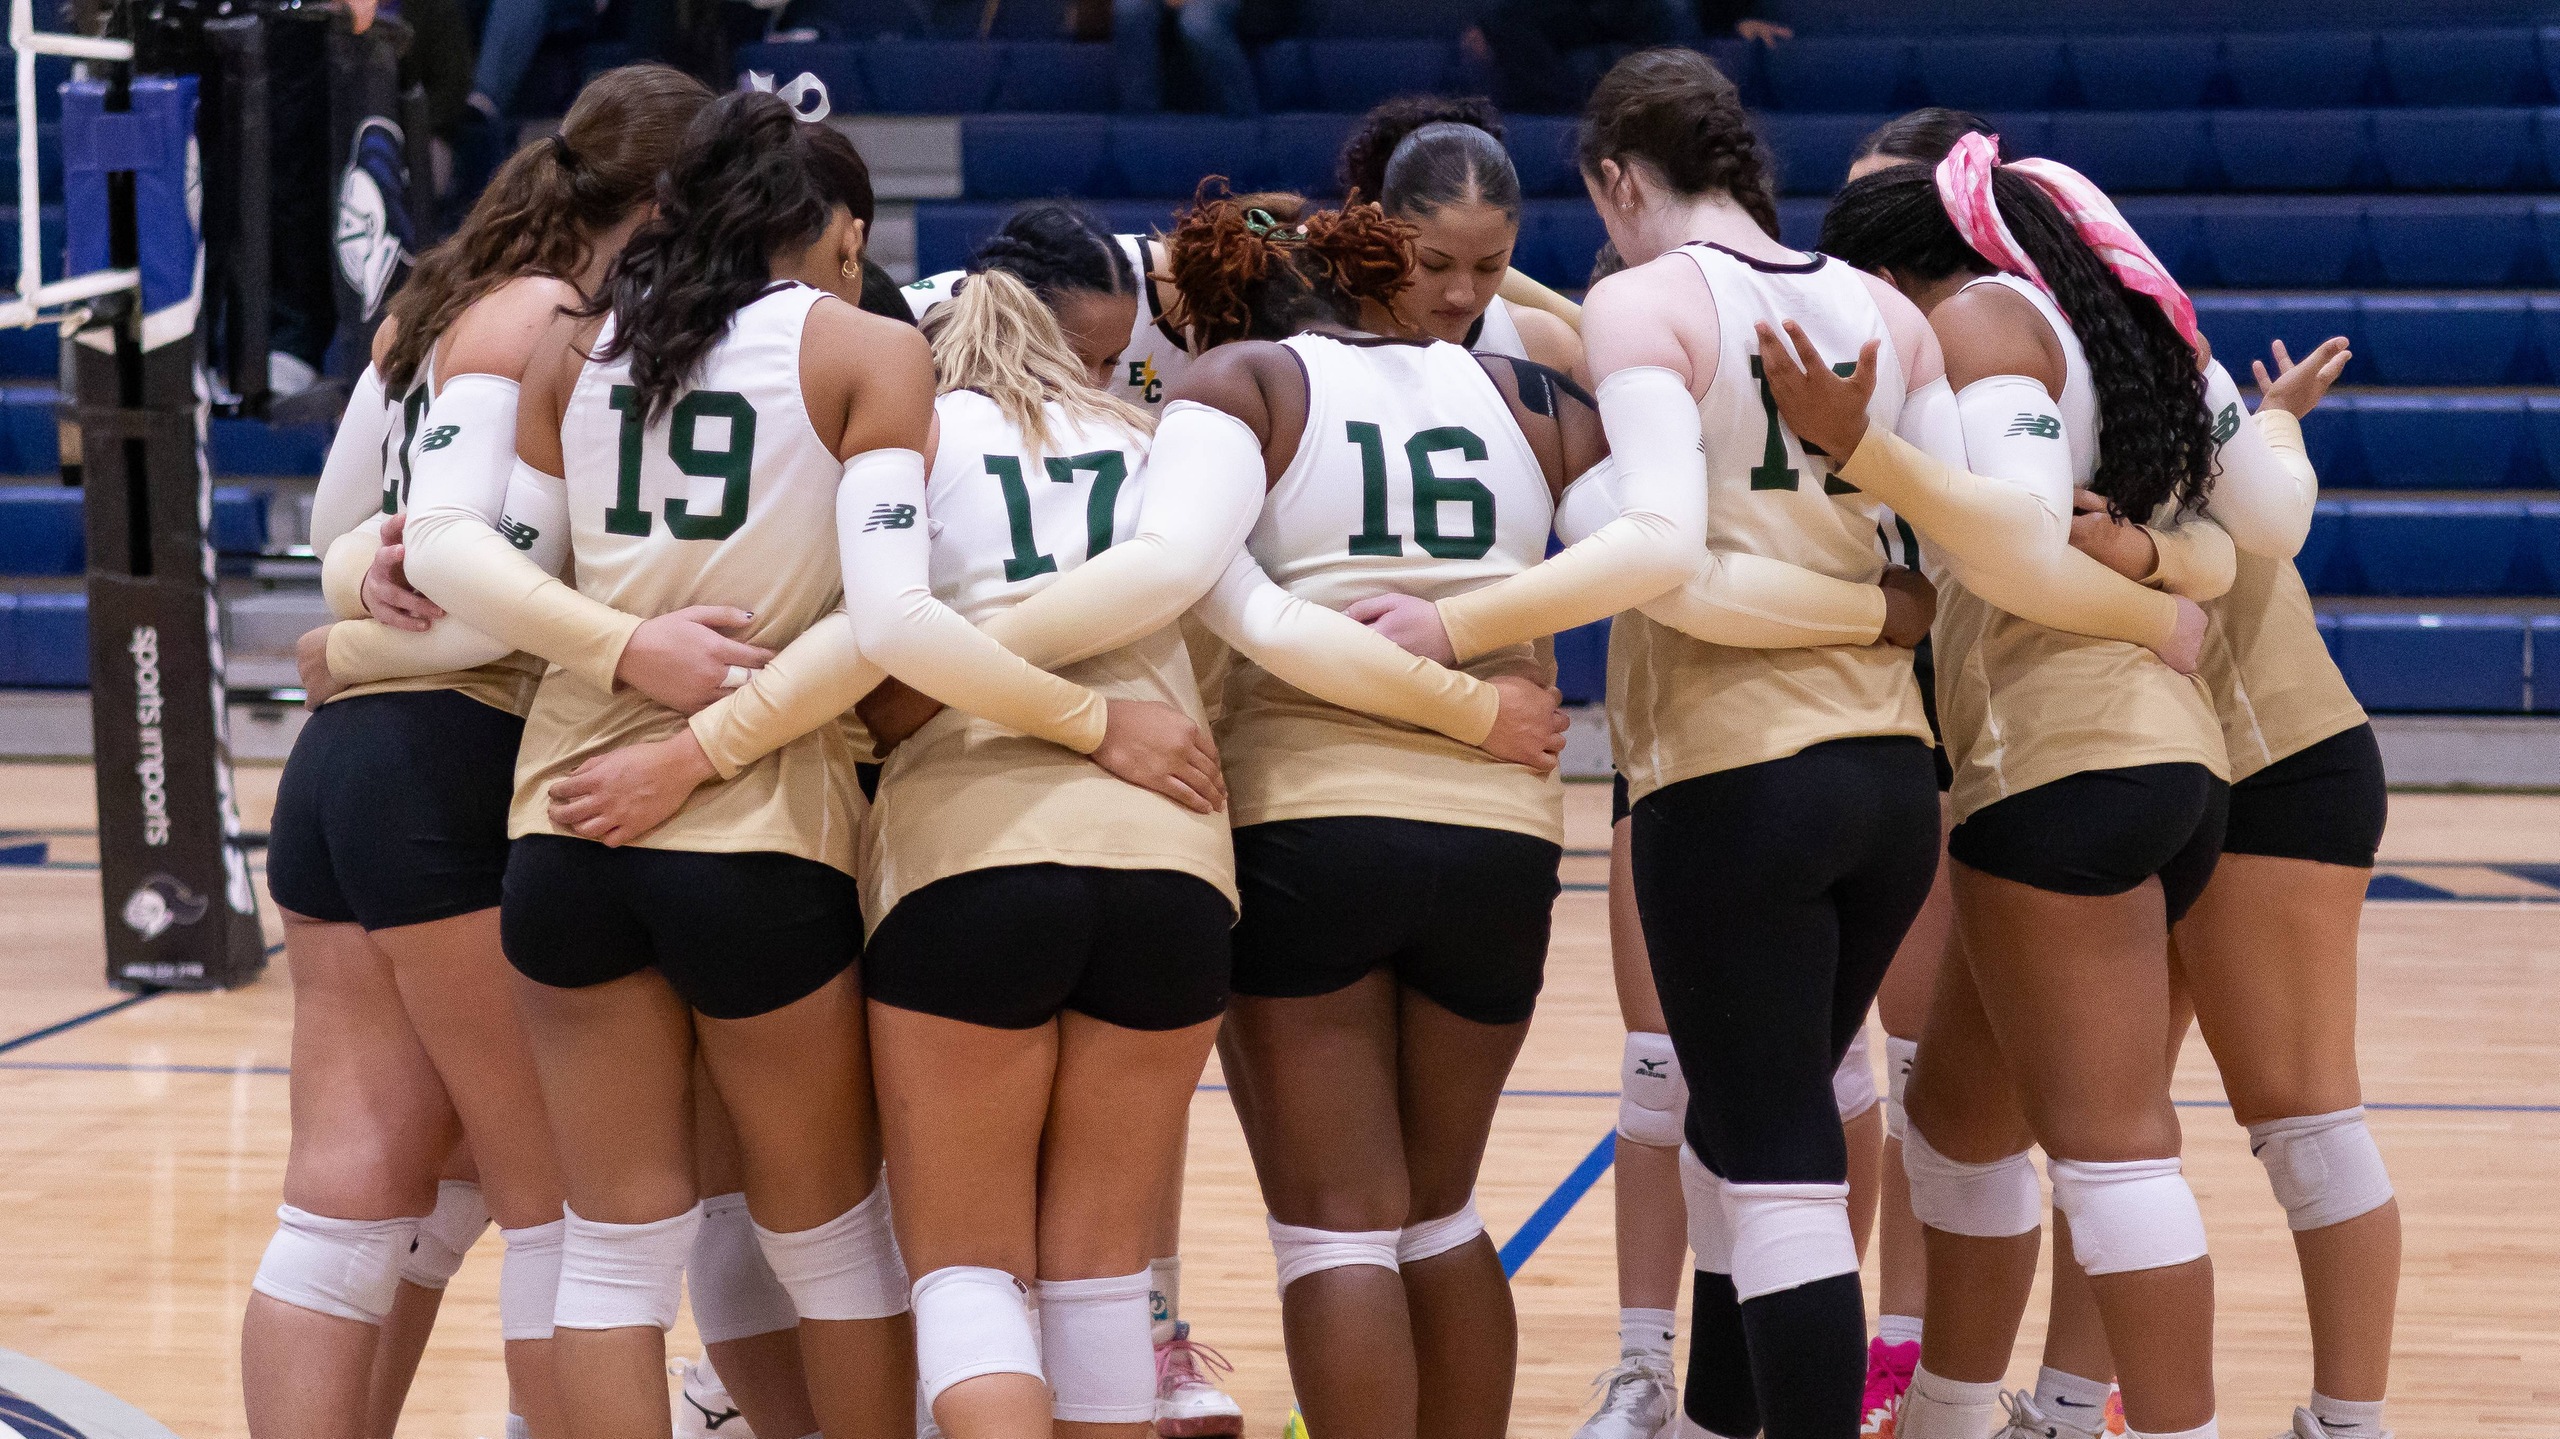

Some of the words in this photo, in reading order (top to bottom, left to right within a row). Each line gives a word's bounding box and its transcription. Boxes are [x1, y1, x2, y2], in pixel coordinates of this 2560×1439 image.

[605, 384, 757, 541] 19
[1345, 420, 1497, 560] 16
[2003, 412, 2062, 440] NB
[862, 503, 917, 533] NB
[983, 449, 1128, 583] 17
